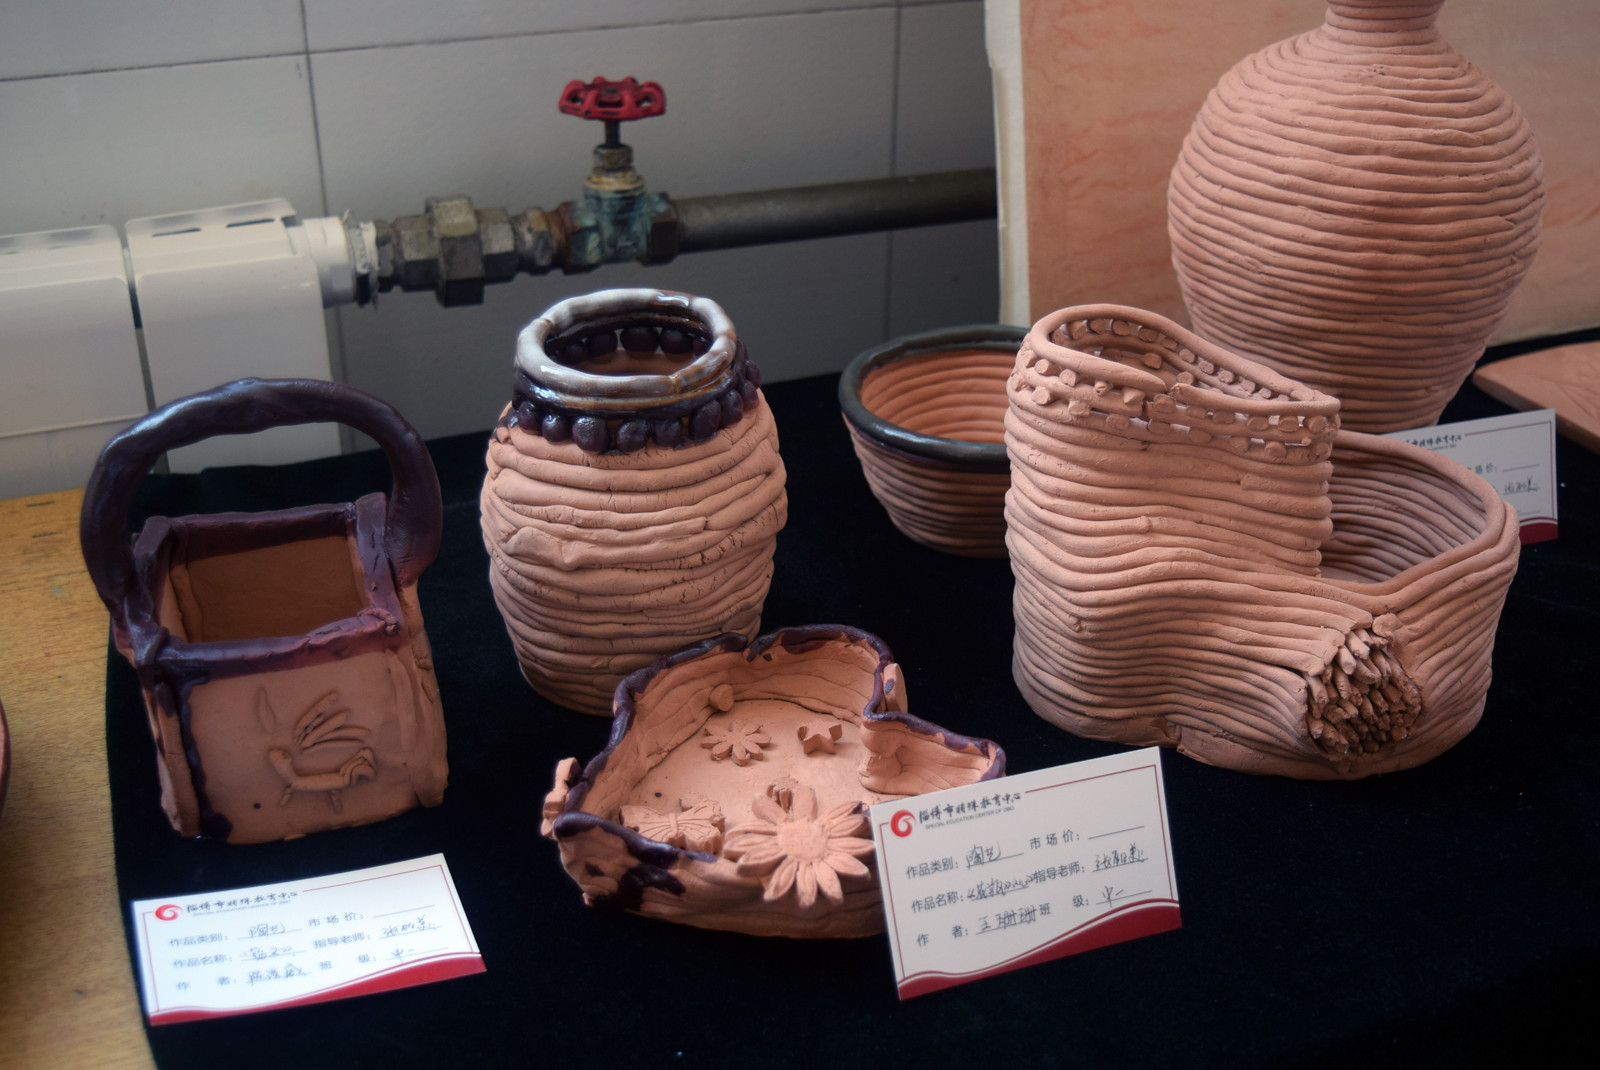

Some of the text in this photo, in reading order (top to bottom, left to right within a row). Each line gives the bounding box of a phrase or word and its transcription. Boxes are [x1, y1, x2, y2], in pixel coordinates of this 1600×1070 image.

[919, 792, 1021, 824] 淄博市特殊教育中心
[906, 856, 959, 879] 作品类别：
[911, 890, 964, 913] 作品名称：
[1034, 861, 1085, 884] 指导老师：
